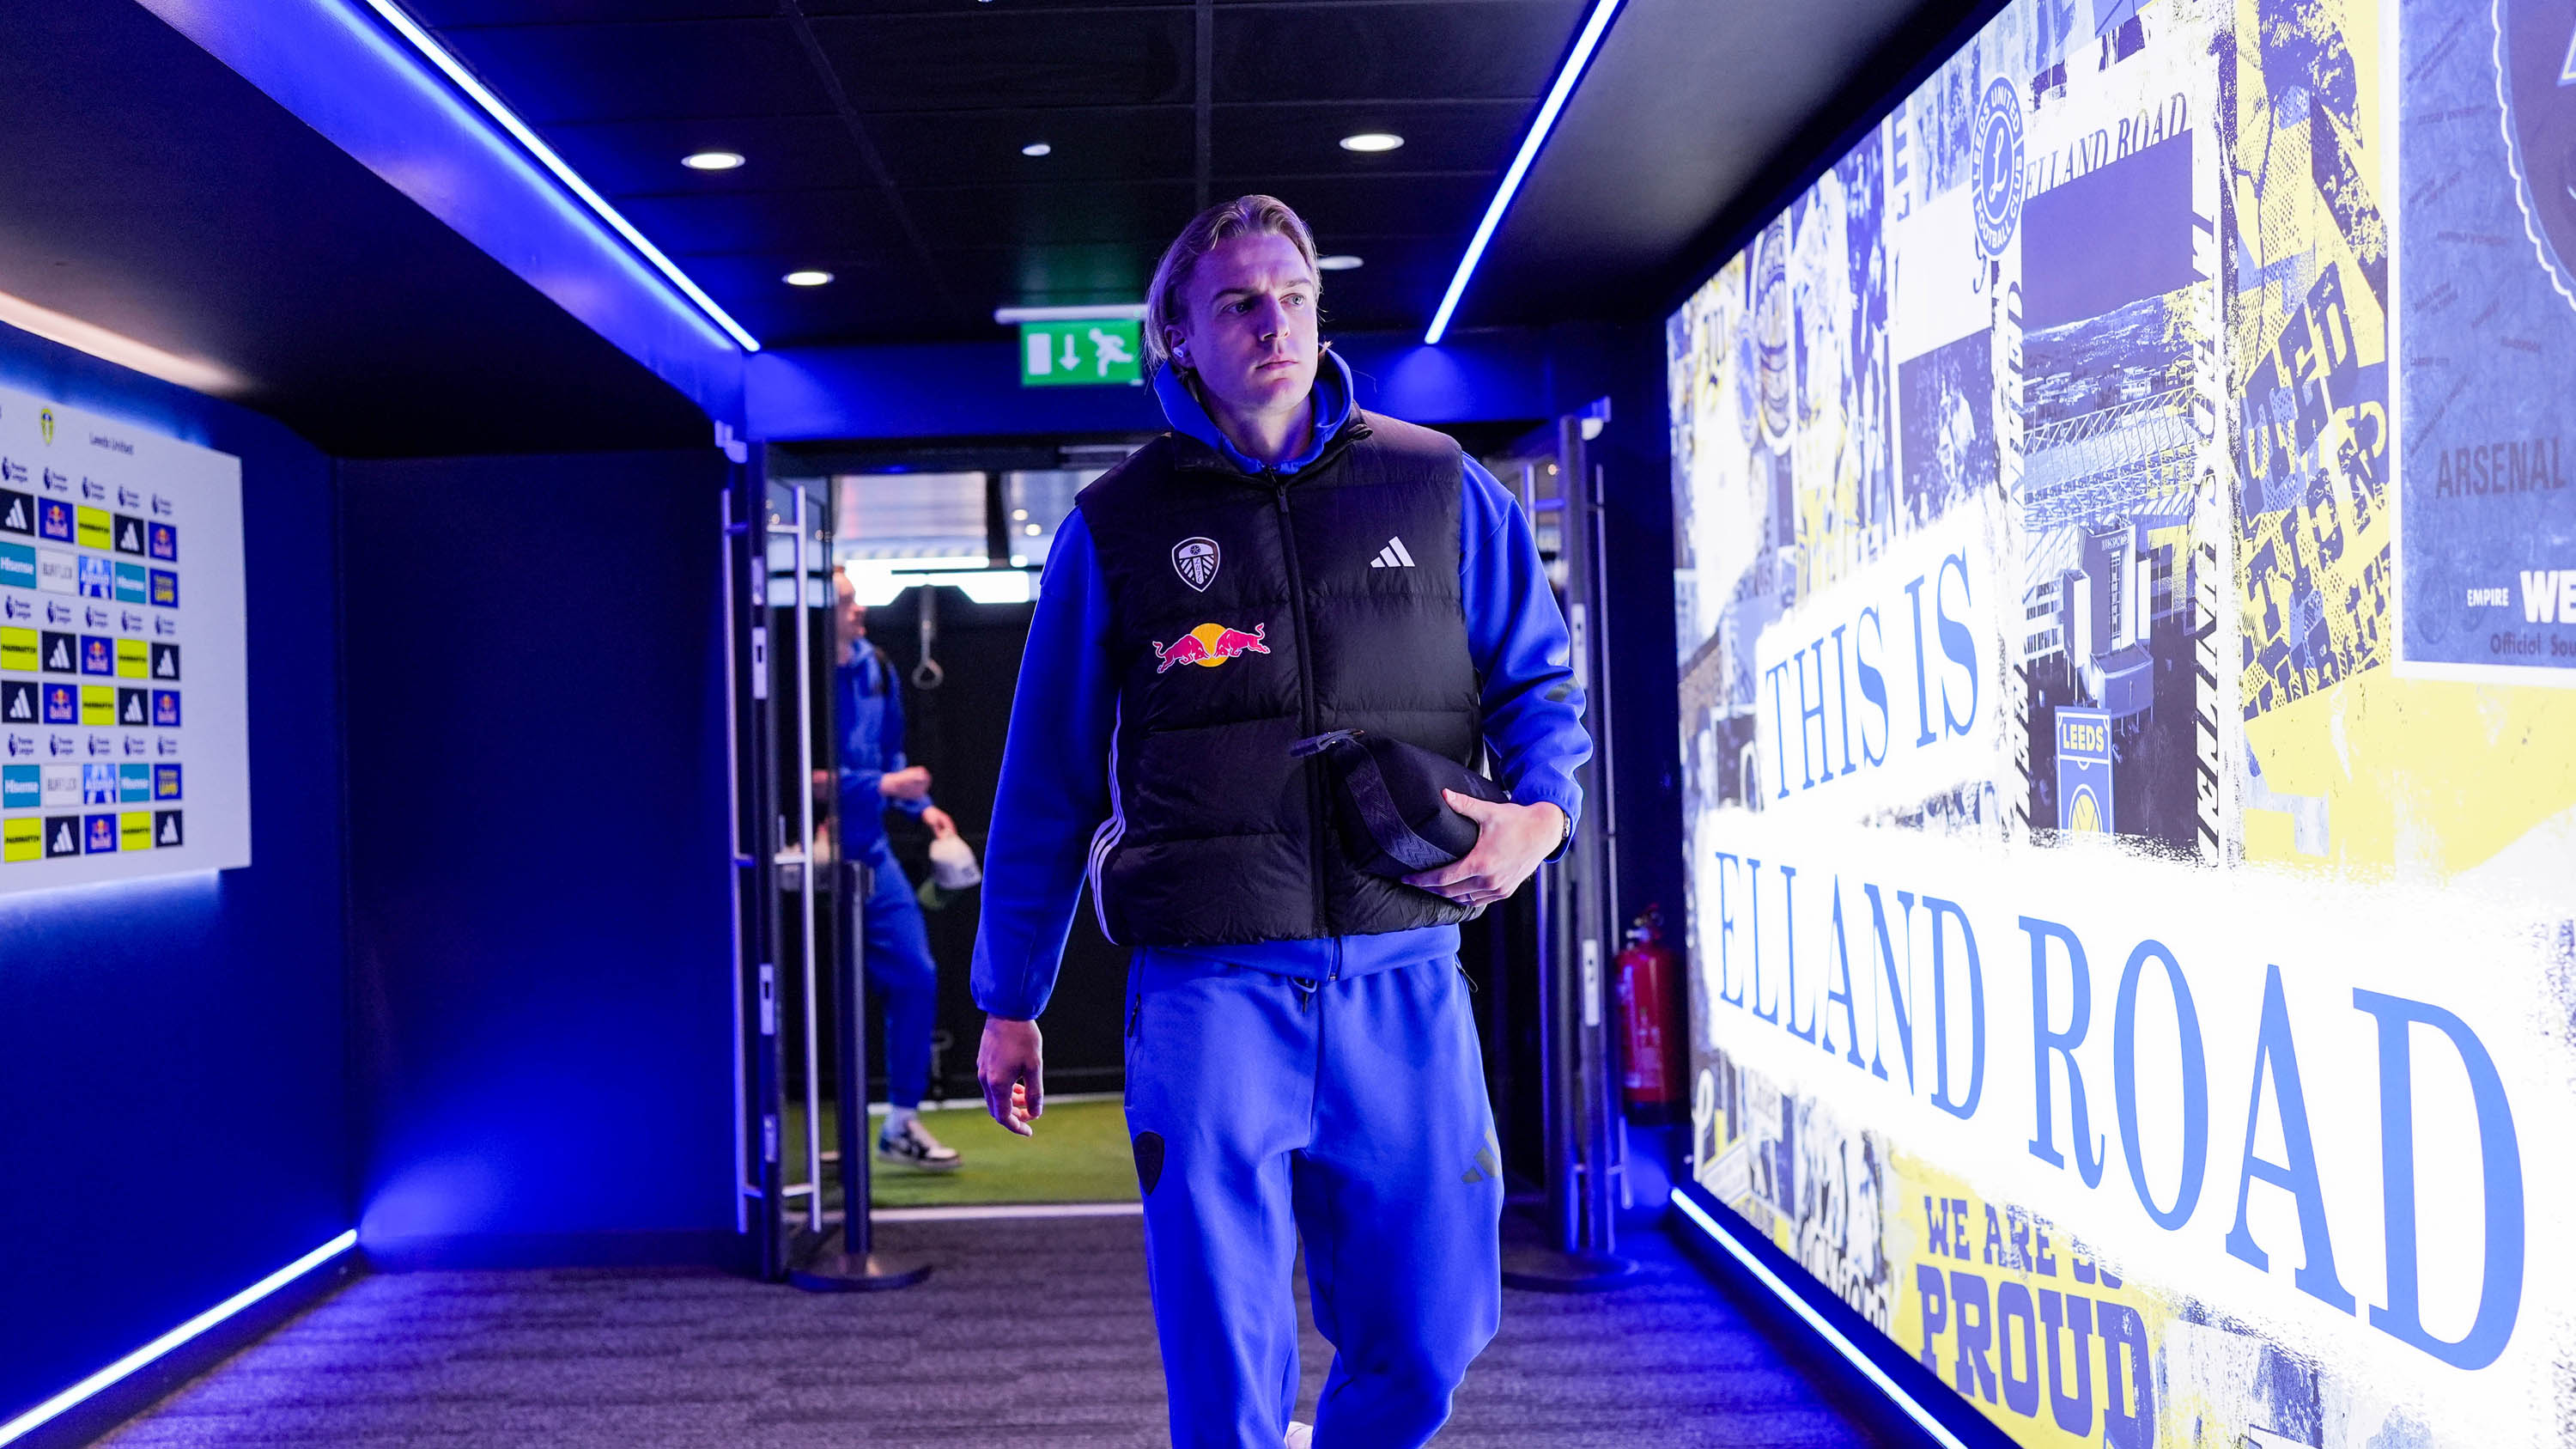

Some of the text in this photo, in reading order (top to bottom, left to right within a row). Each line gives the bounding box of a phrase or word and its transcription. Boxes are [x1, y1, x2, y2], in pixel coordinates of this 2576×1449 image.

[1973, 86, 2020, 181] LEEDS UNITED
[2025, 92, 2187, 200] ELLAND ROAD
[1976, 155, 2022, 249] FOOTBALL CLUB
[2435, 435, 2567, 500] ARSENAL
[2467, 588, 2510, 607] EMPIRE
[2490, 630, 2542, 655] Official
[1765, 545, 1979, 800] THIS IS
[2063, 723, 2105, 753] LEEDS
[1715, 850, 2525, 1371] ELLAND ROAD
[1924, 1196, 1971, 1261] WE
[1984, 1202, 2057, 1278] ARE
[1916, 1263, 2156, 1449] PROUD
